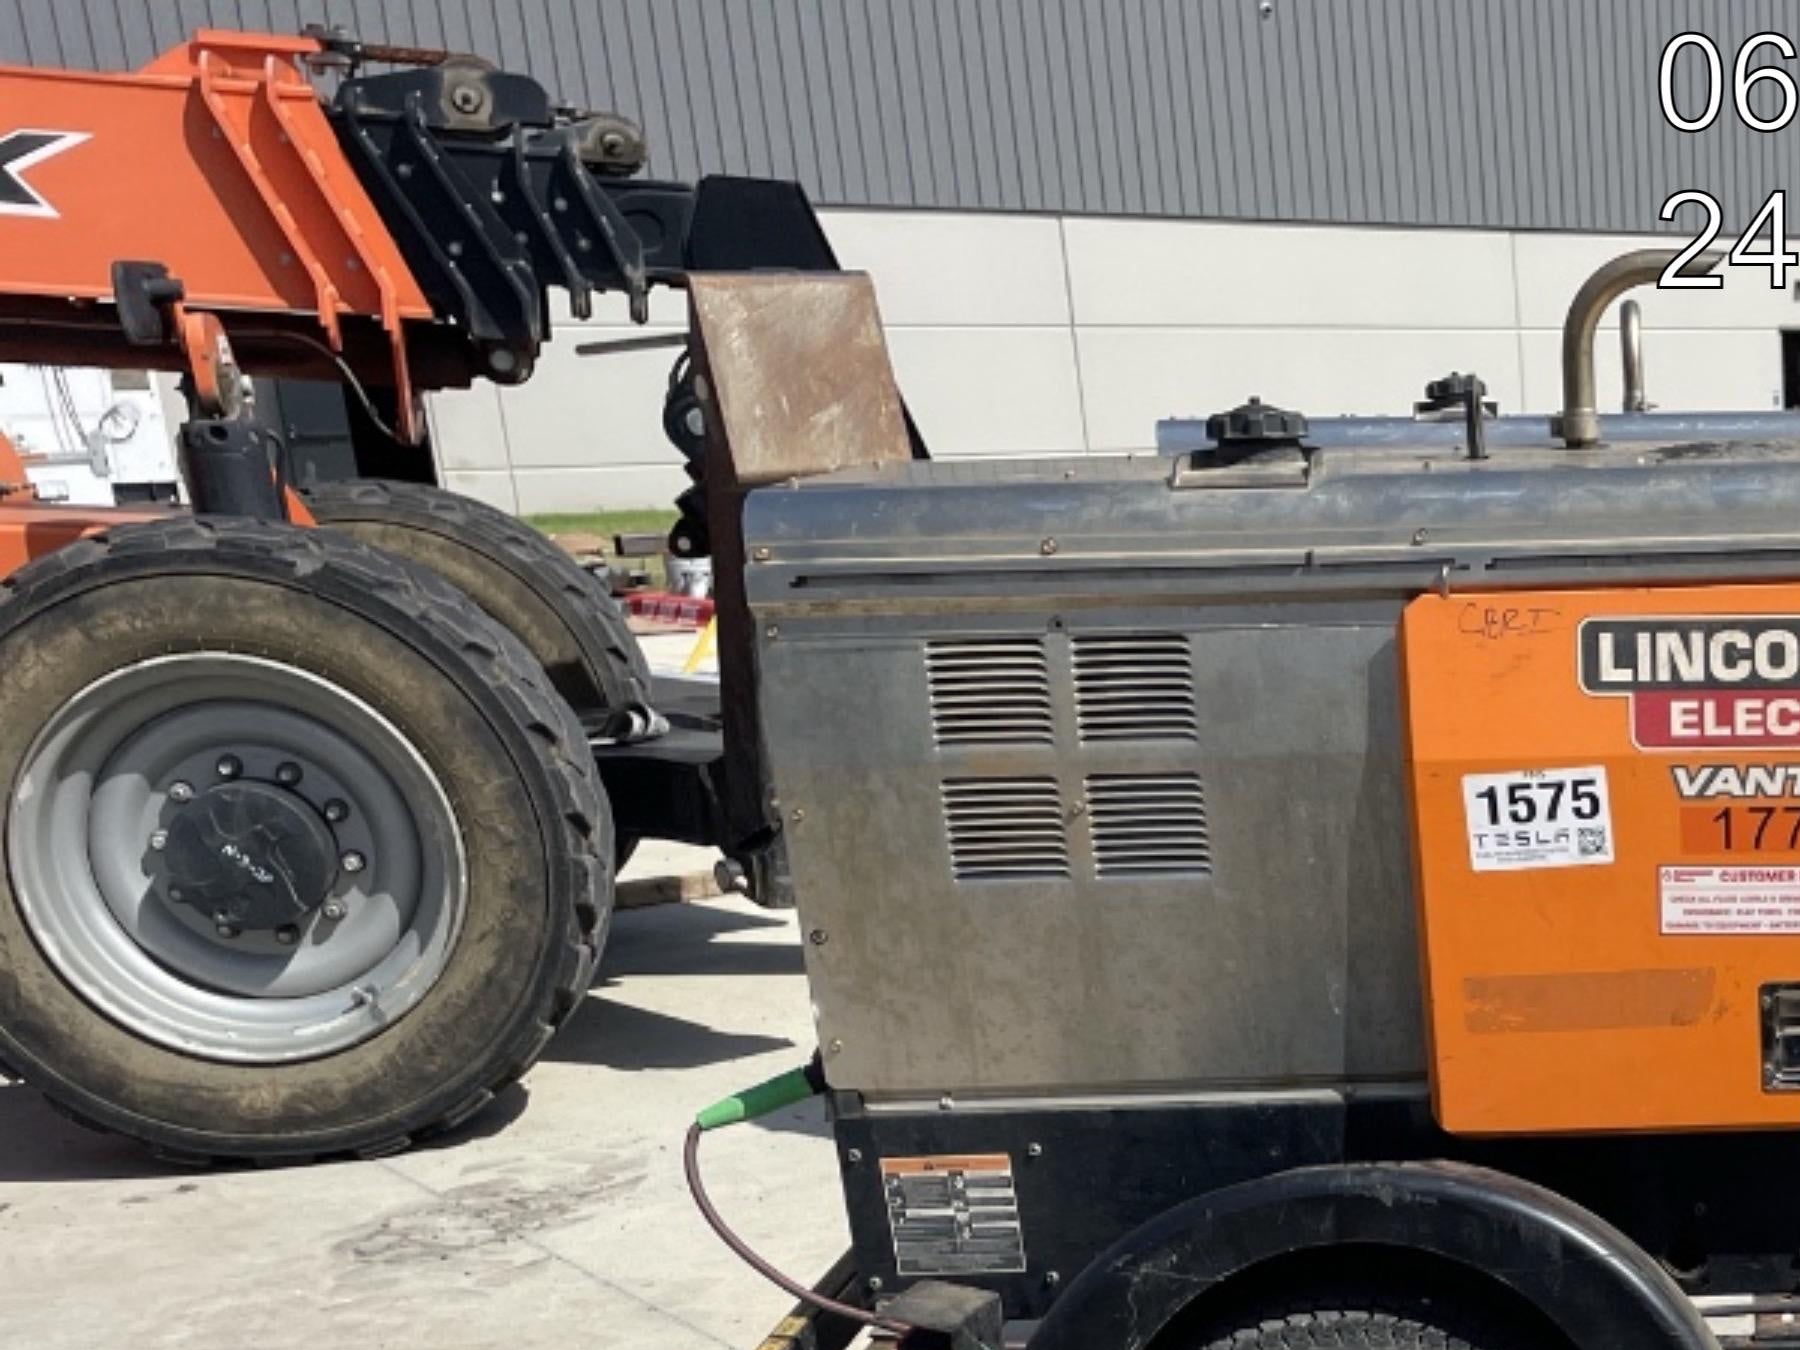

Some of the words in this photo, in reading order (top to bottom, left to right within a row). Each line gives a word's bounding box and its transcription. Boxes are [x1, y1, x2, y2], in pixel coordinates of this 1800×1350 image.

[1475, 778, 1601, 826] 1575
[1473, 827, 1570, 850] TESLA
[1718, 869, 1795, 883] CUSTOMER
